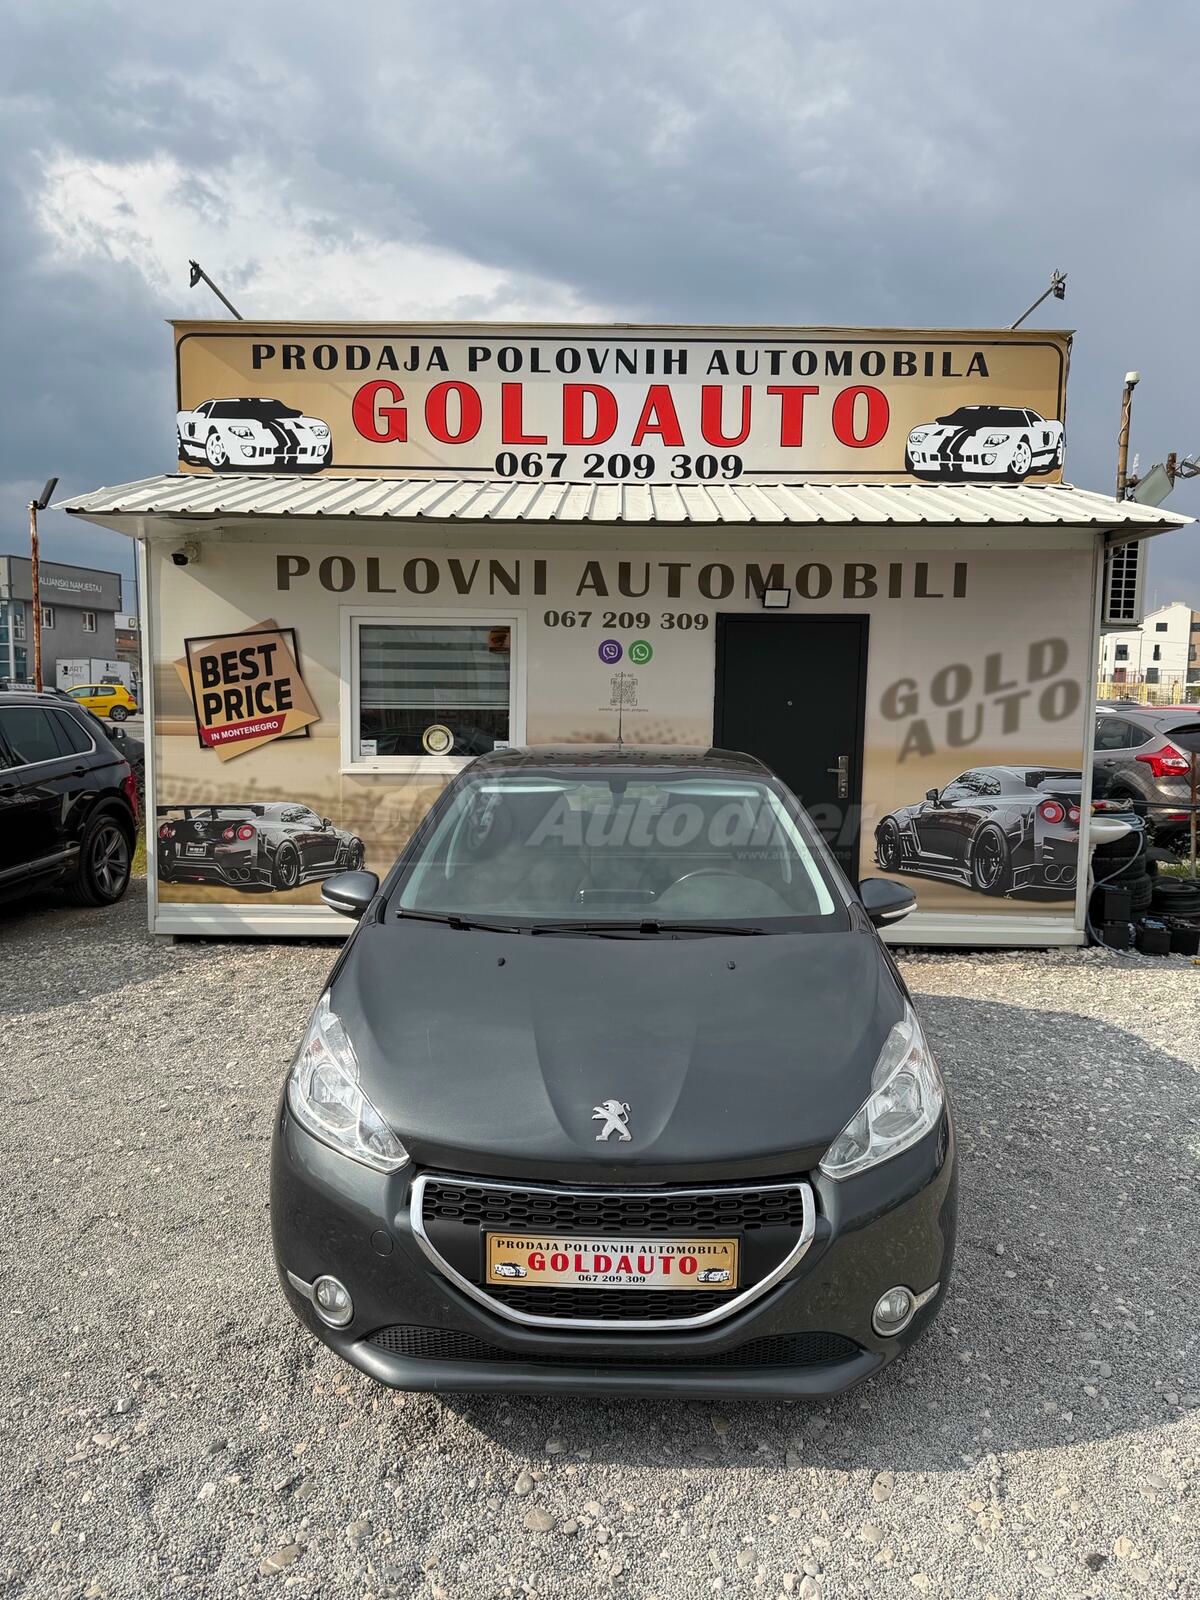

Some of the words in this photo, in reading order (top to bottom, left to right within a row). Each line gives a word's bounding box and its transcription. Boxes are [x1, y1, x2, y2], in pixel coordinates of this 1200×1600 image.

[252, 344, 450, 373] PRODAJA
[468, 346, 688, 375] POLOVNIH
[706, 349, 990, 377] AUTOMOBILA
[351, 379, 890, 448] GOLDAUTO
[495, 452, 568, 478] 067
[583, 453, 655, 479] 209
[670, 454, 744, 480] 309
[276, 555, 547, 596] POLOVNI
[576, 560, 968, 600] AUTOMOBILI
[543, 610, 593, 628] 067
[602, 611, 651, 630] 209
[660, 612, 709, 631] 309
[200, 642, 278, 689] BEST
[880, 637, 1069, 721] GOLD
[203, 678, 294, 726] PRICE
[211, 733, 220, 741] IN
[221, 721, 279, 739] MONTENEGRO
[897, 679, 1081, 764] AUTO
[497, 1240, 559, 1251] PRODAJA
[564, 1243, 635, 1254] POLOVNIH
[640, 1245, 729, 1255] AUTOMOBILA
[527, 1252, 699, 1275] GOLDAUTO
[578, 1274, 599, 1282] 067
[601, 1275, 622, 1283] 209
[625, 1276, 646, 1284] 309
